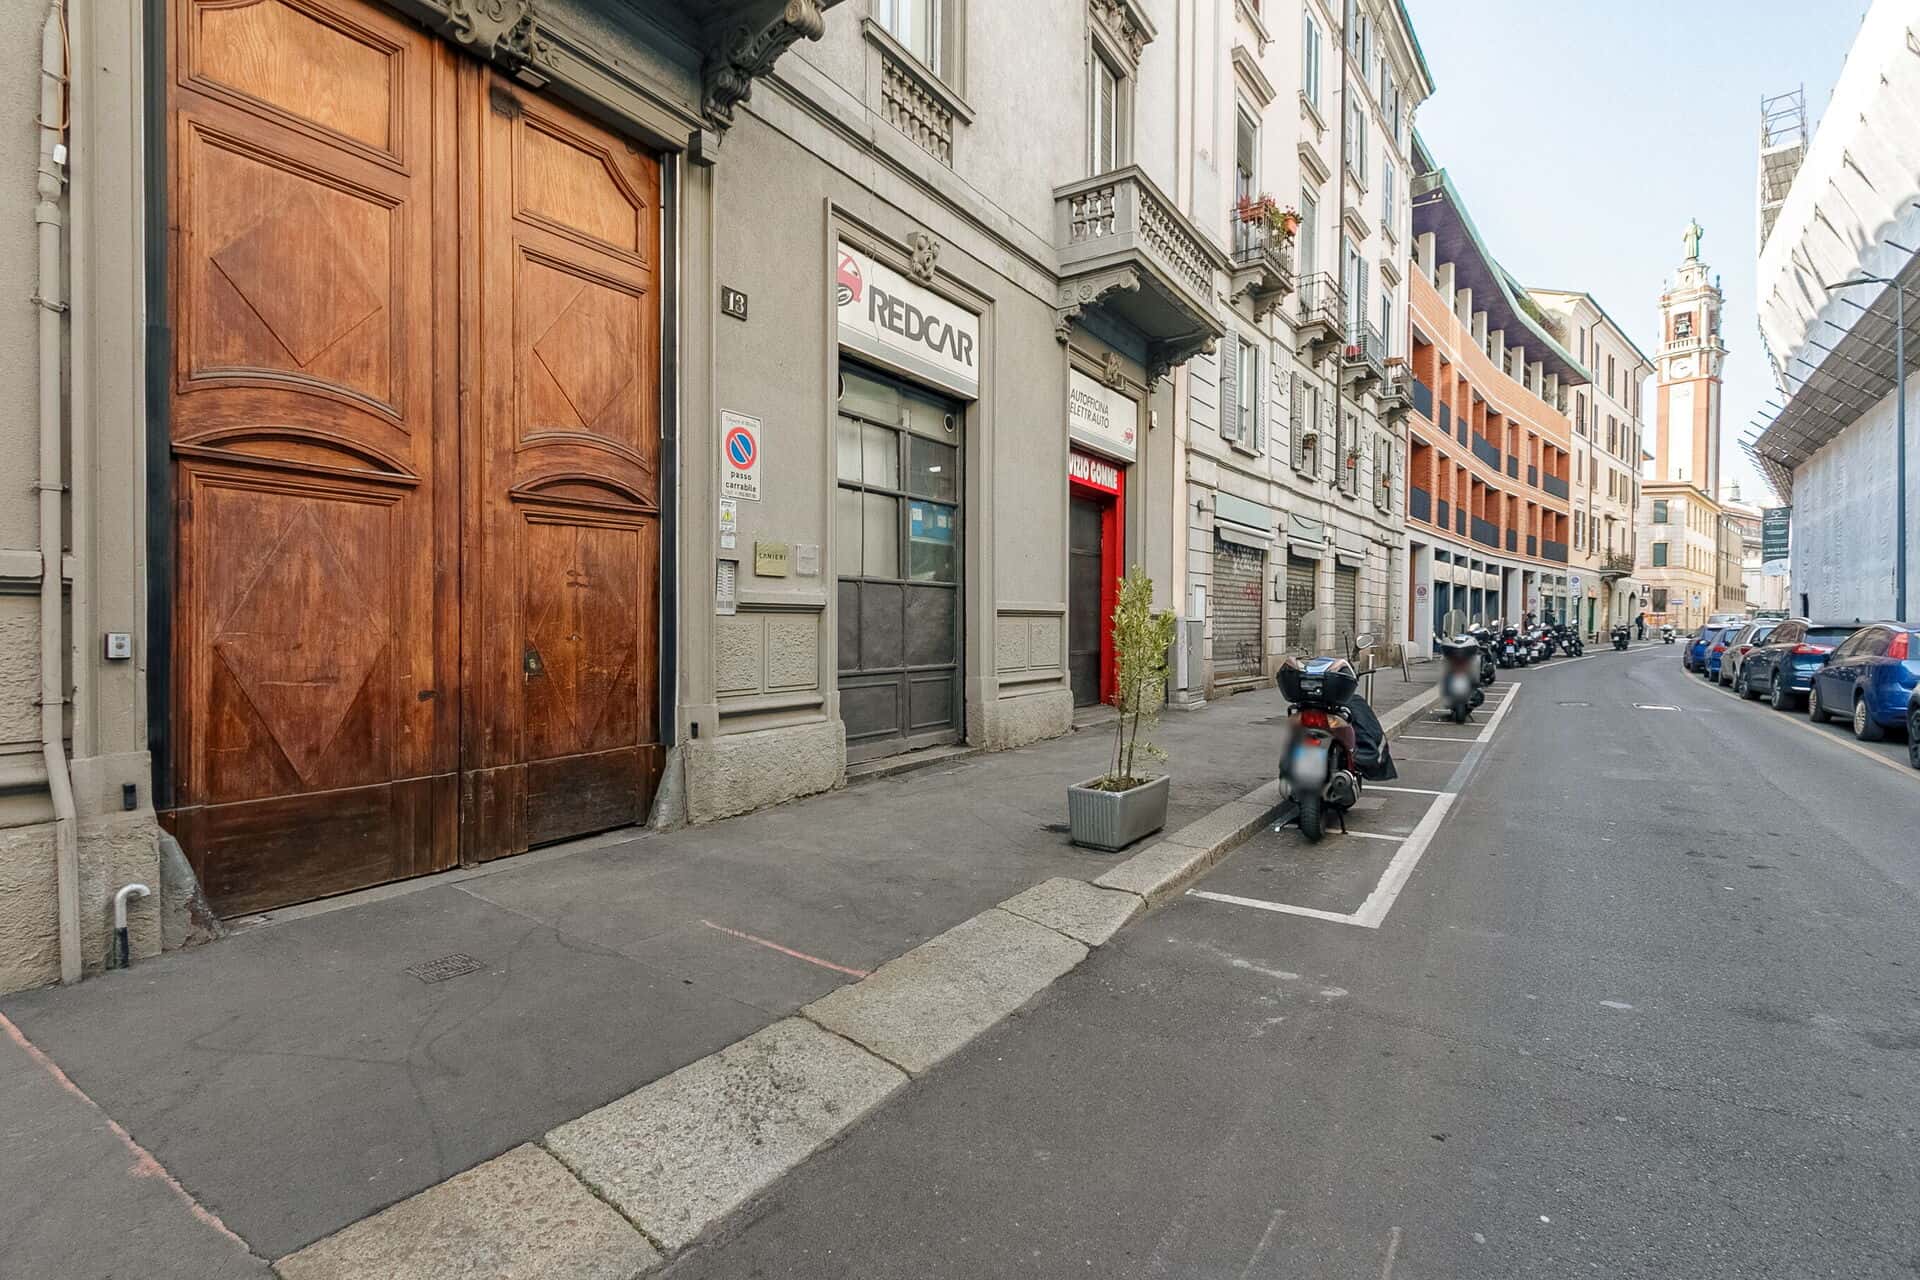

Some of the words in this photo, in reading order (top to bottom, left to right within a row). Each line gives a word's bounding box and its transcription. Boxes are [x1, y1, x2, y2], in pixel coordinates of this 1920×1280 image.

[728, 291, 745, 314] 13
[868, 284, 973, 367] REDCAR
[1070, 388, 1109, 417] AUTOFFICINA
[1070, 405, 1110, 429] ELETTRAUTO
[725, 481, 757, 492] carrabile
[730, 471, 752, 481] passo
[1090, 461, 1118, 490] GOMME
